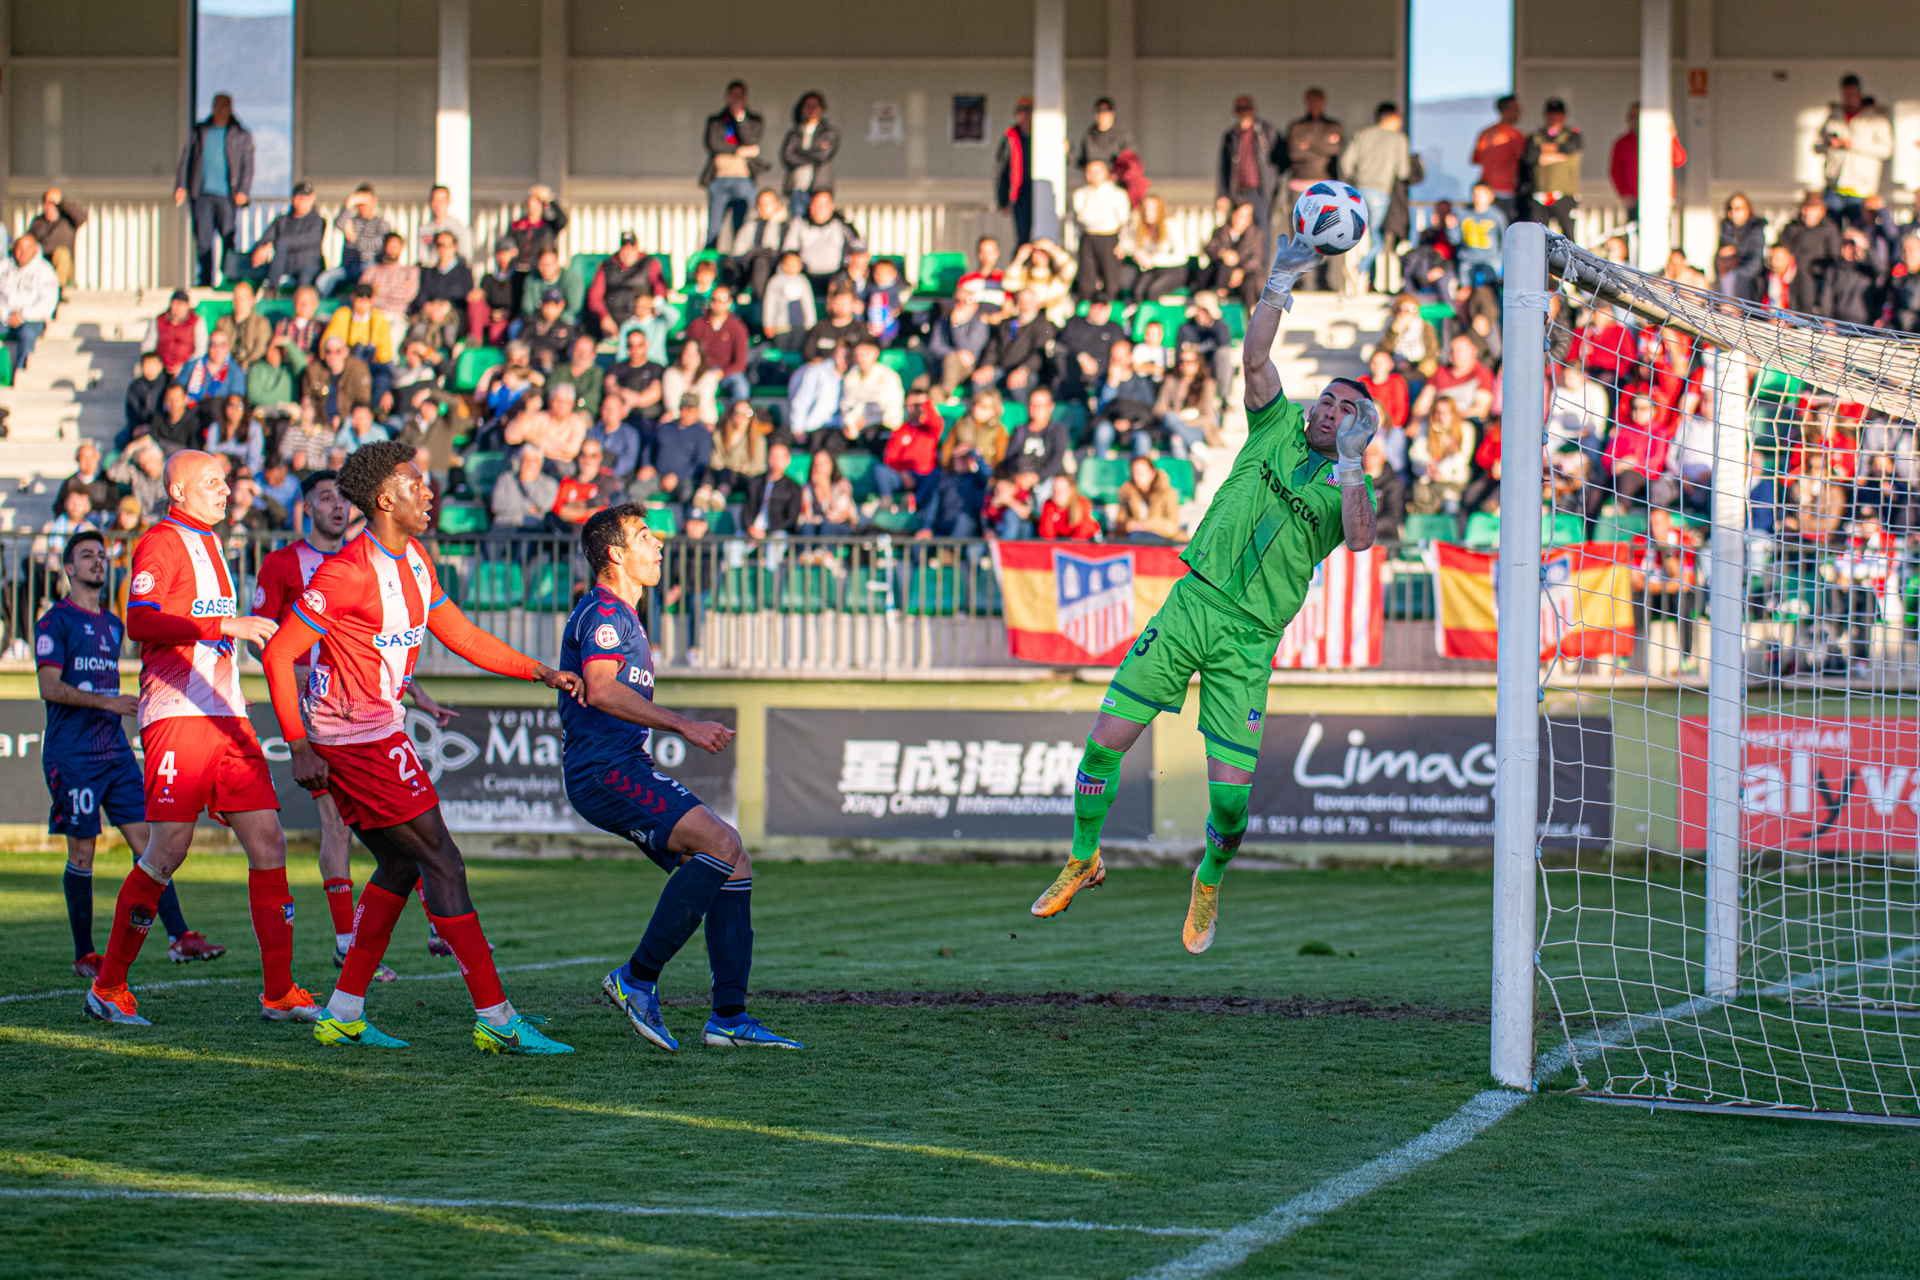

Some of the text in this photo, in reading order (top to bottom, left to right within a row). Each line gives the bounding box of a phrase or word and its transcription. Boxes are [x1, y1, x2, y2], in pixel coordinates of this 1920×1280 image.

[192, 598, 236, 617] SASEG
[1134, 625, 1158, 657] 3
[488, 709, 560, 729] venta
[157, 751, 178, 785] 4
[388, 740, 424, 782] 21
[67, 787, 95, 815] 10
[842, 792, 888, 818] Xing
[889, 792, 950, 819] Cheng
[1410, 792, 1488, 813] industrial
[1741, 750, 1920, 838] alyv
[437, 796, 554, 822] amagullo.es
[1267, 815, 1298, 835] 921
